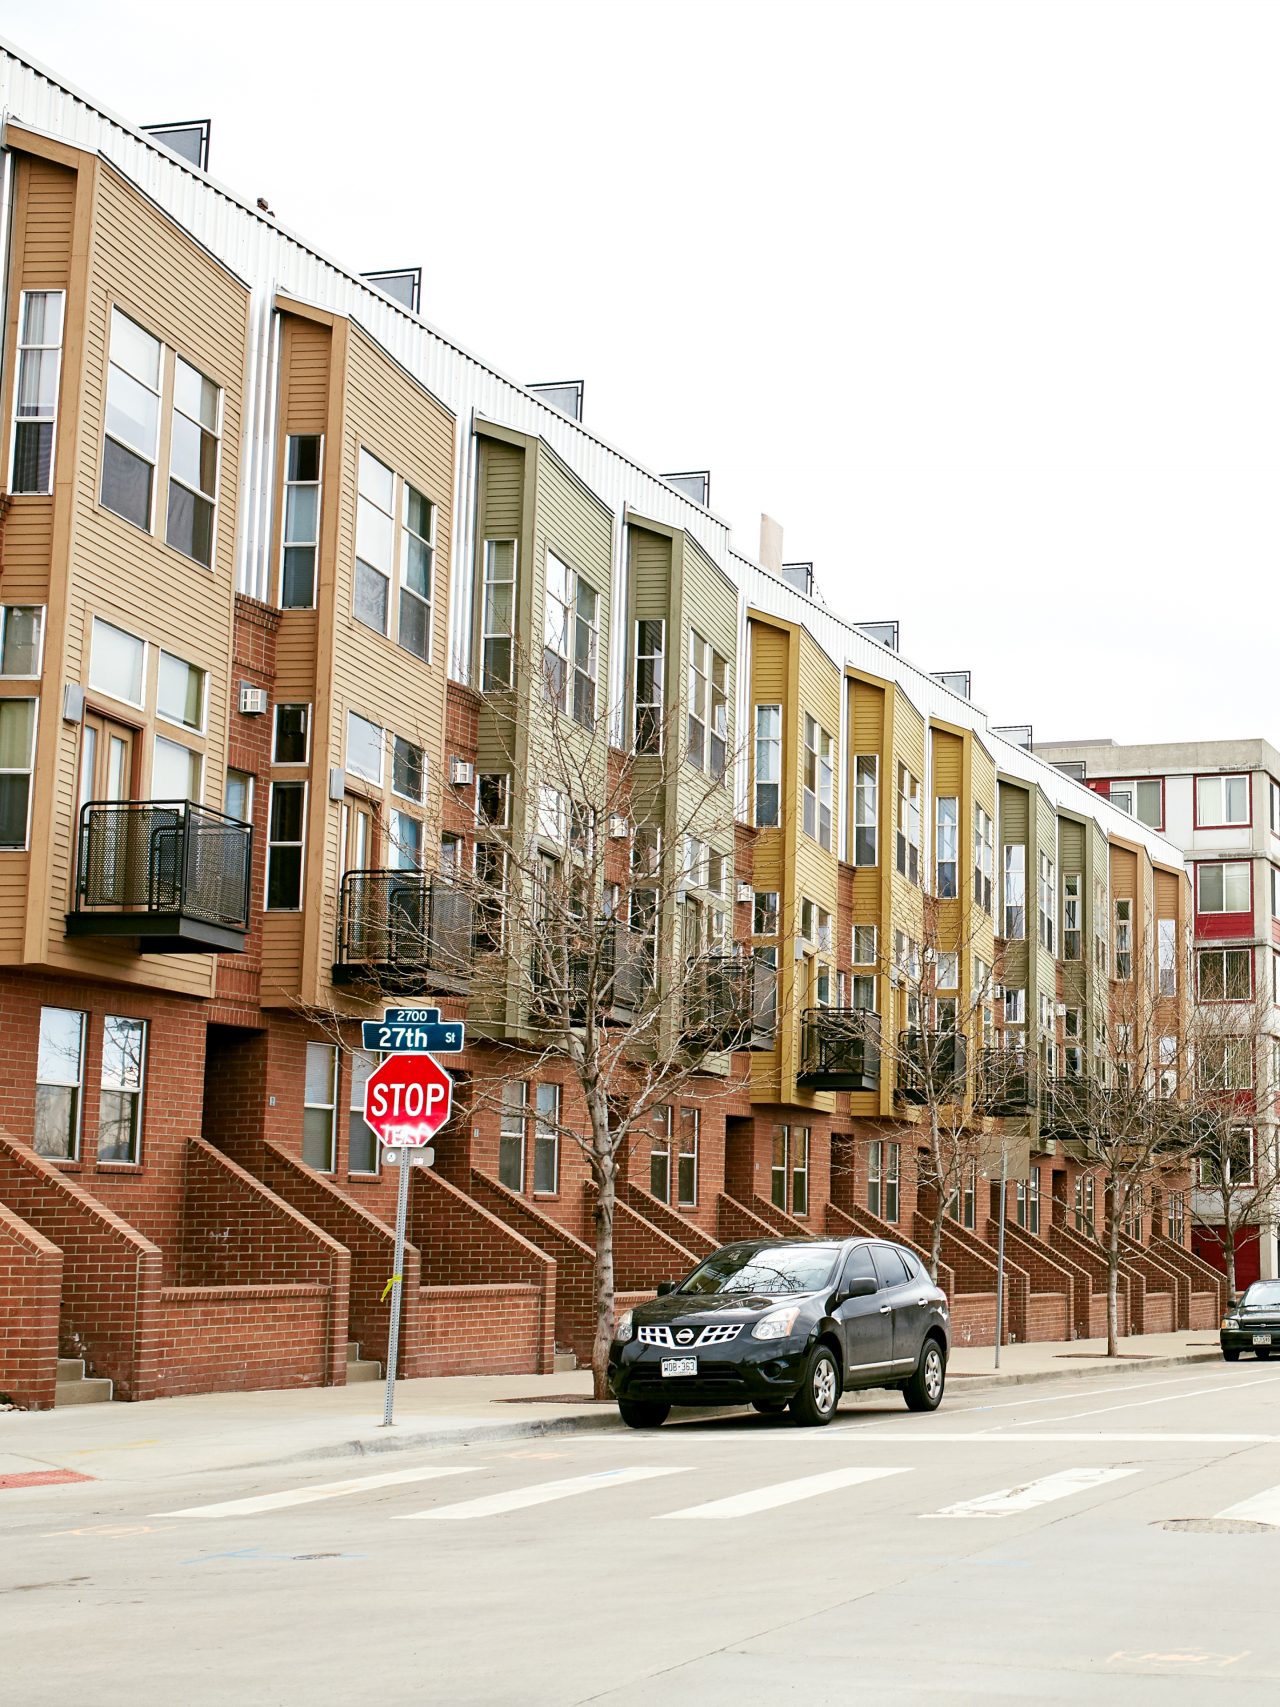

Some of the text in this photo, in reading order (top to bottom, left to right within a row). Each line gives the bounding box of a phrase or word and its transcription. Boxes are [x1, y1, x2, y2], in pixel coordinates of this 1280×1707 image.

[397, 1010, 428, 1022] 2700
[378, 1027, 456, 1048] 27th St
[370, 1083, 445, 1117] STOP
